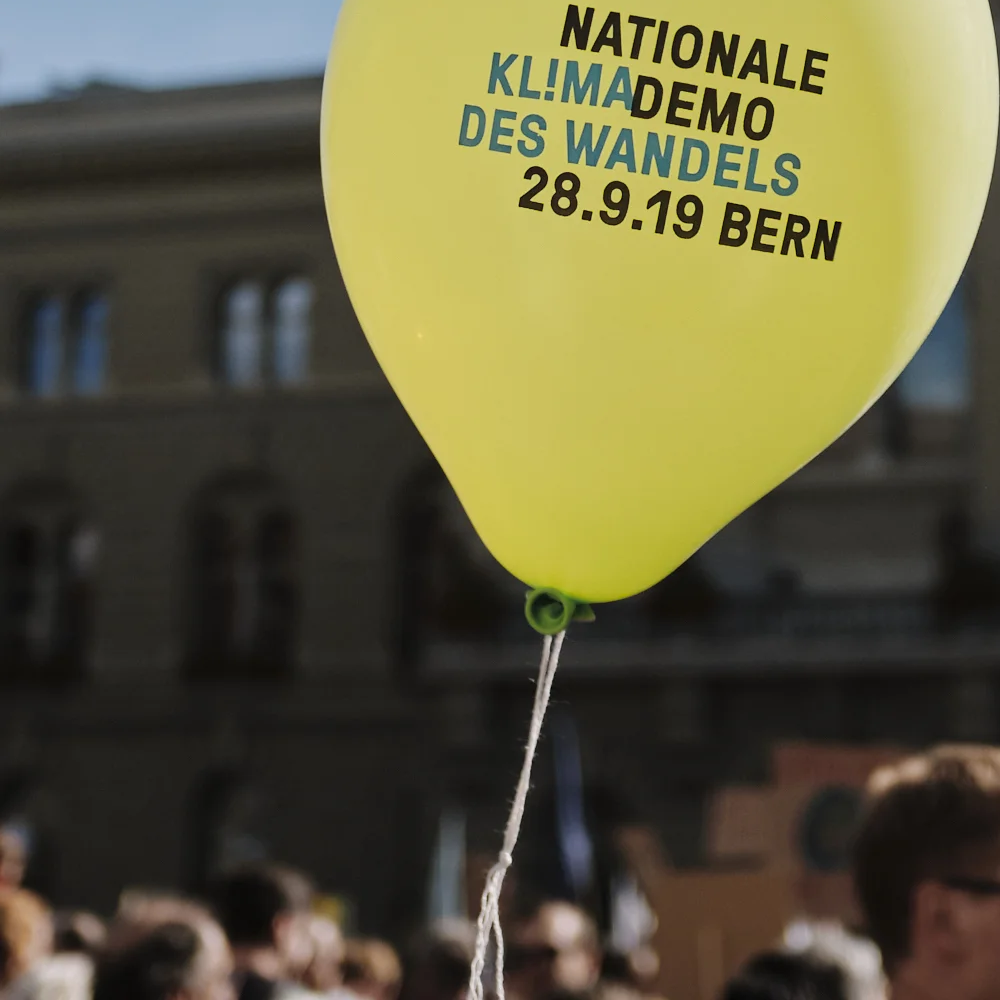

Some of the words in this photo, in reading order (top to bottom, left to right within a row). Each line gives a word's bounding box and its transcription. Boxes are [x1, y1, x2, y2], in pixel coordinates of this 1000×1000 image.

[560, 4, 829, 95] NATIONALE
[458, 103, 548, 159] DES
[566, 119, 802, 197] WANDELS
[518, 165, 704, 240] 28.9.19
[717, 201, 843, 262] BERN
